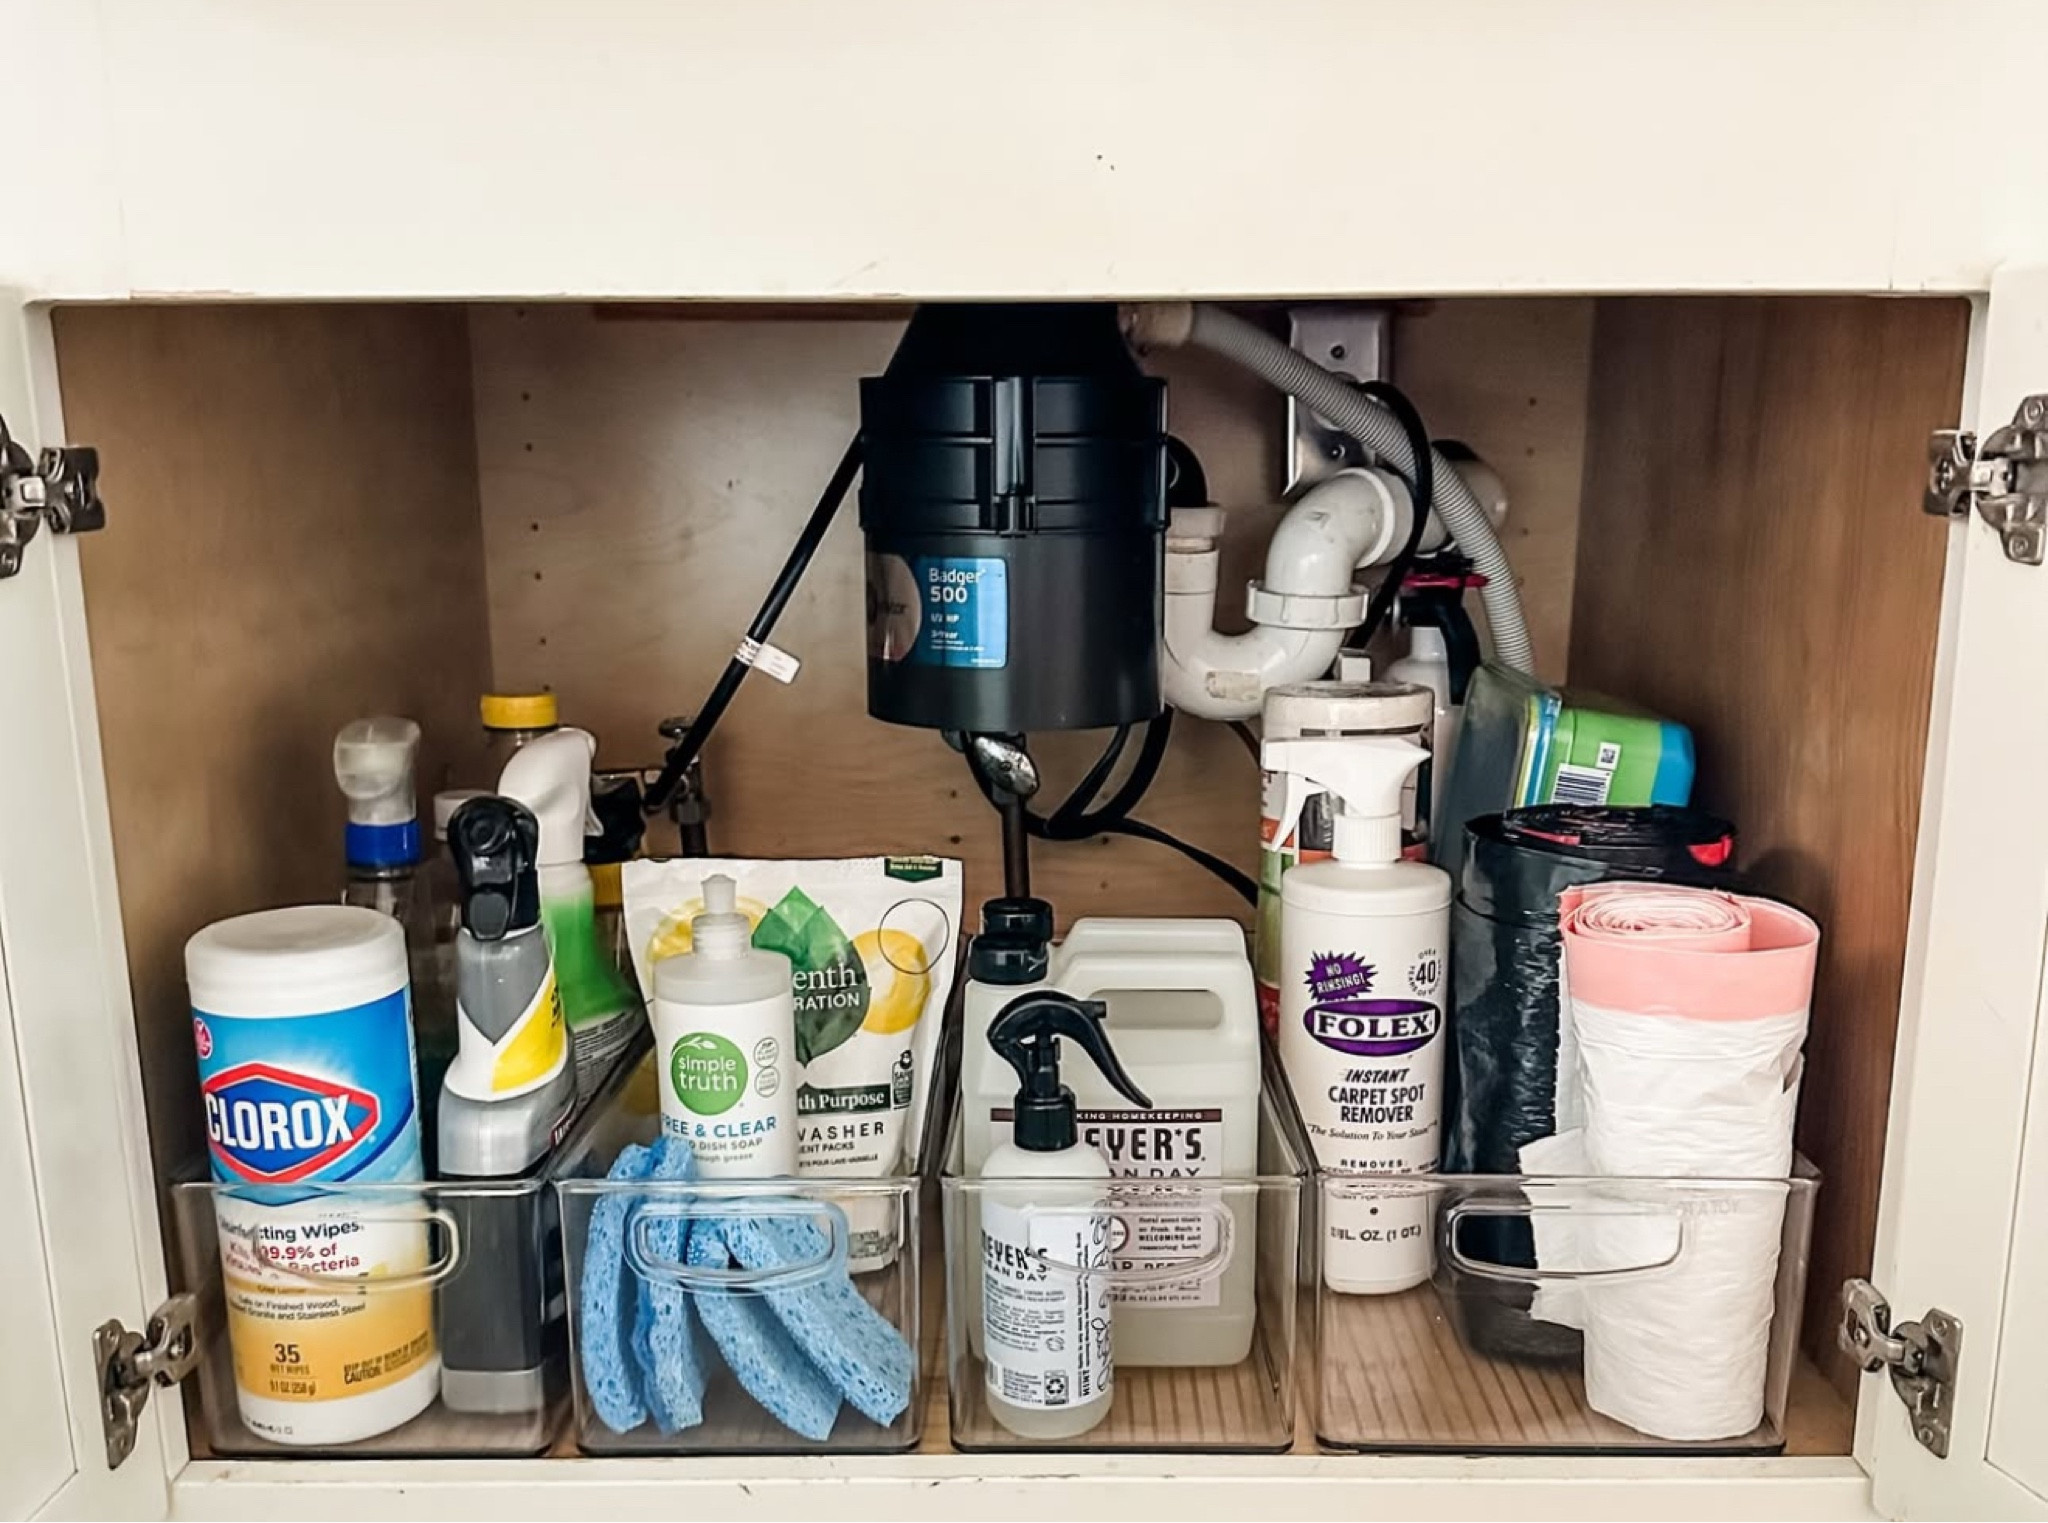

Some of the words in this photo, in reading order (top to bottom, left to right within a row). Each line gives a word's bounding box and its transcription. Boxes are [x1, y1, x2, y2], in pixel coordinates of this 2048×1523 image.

[928, 567, 981, 585] Badger
[930, 585, 968, 603] 500
[792, 962, 858, 991] enth
[1324, 963, 1342, 977] NO
[1416, 960, 1436, 985] 40
[1316, 972, 1366, 994] RINSING!
[794, 992, 860, 1011] RATION
[1318, 1014, 1429, 1039] FOLEX
[678, 1054, 737, 1074] simple
[679, 1072, 738, 1092] truth
[1344, 1068, 1410, 1084] INSTANT
[798, 1094, 816, 1110] th
[819, 1091, 885, 1113] Purpose
[1328, 1086, 1386, 1106] CARPET
[1391, 1083, 1425, 1105] SPOT
[205, 1091, 354, 1151] CLOROX
[1076, 1113, 1106, 1121] KING
[1112, 1113, 1203, 1121] HOMEKEEPING
[1340, 1105, 1414, 1124] REMOVER
[694, 1123, 706, 1138] &
[713, 1116, 777, 1138] CLEAR
[1328, 1128, 1369, 1140] Solution
[1372, 1131, 1385, 1141] To
[1387, 1130, 1407, 1141] Your
[699, 1141, 727, 1151] DISH
[730, 1137, 763, 1149] SOAP
[821, 1141, 855, 1152] PACKS
[1085, 1127, 1203, 1161] EYER'S
[301, 1220, 360, 1240] Wipes
[320, 1242, 338, 1258] of
[981, 1229, 1048, 1274] EYER'S
[1015, 1270, 1048, 1282] DAY
[266, 1300, 304, 1311] Finished
[277, 1309, 295, 1320] and
[297, 1308, 339, 1321] Stainless
[274, 1343, 301, 1364] 35
[269, 1364, 284, 1375] WET
[286, 1364, 311, 1376] WIPES
